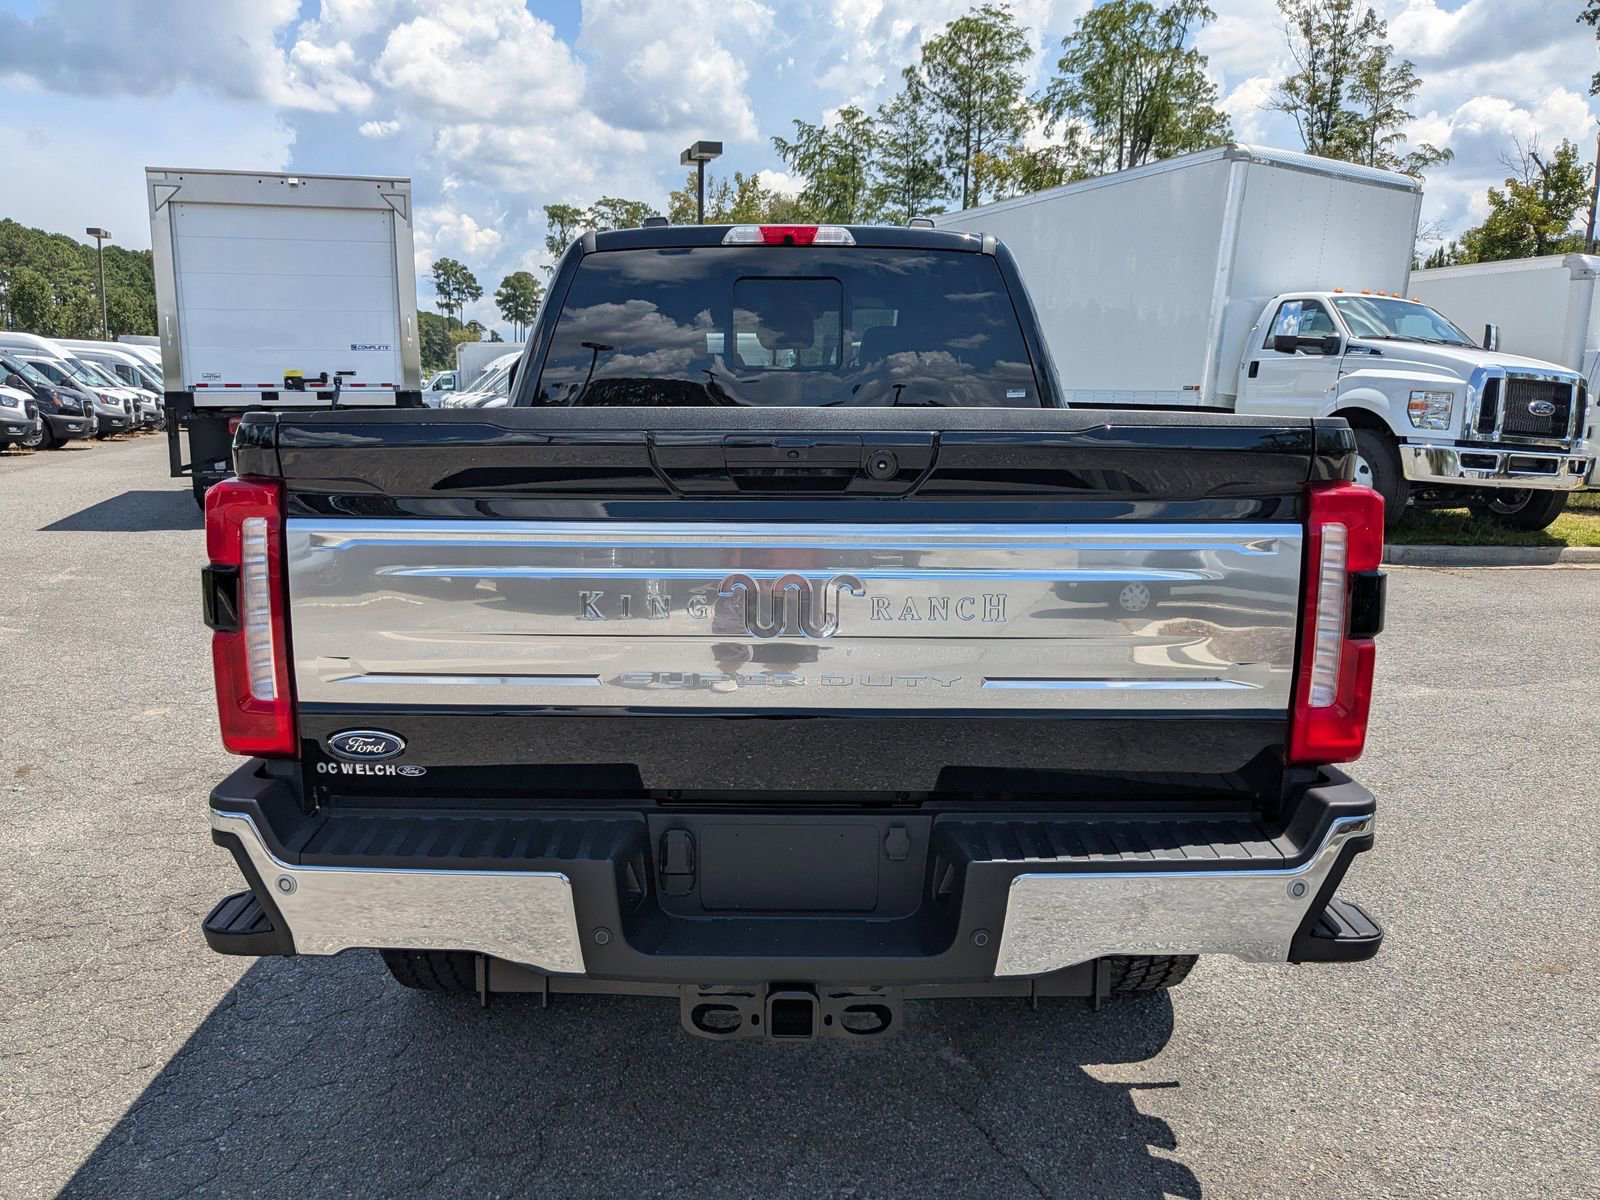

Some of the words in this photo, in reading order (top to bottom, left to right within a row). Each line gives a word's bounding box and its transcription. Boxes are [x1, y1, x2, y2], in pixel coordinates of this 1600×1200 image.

[576, 590, 708, 621] KING
[870, 594, 1008, 623] RANCH
[621, 671, 805, 690] SUPER
[821, 672, 962, 687] DUTY
[346, 736, 386, 753] Ford
[316, 762, 338, 774] OC
[341, 763, 397, 776] WELCH
